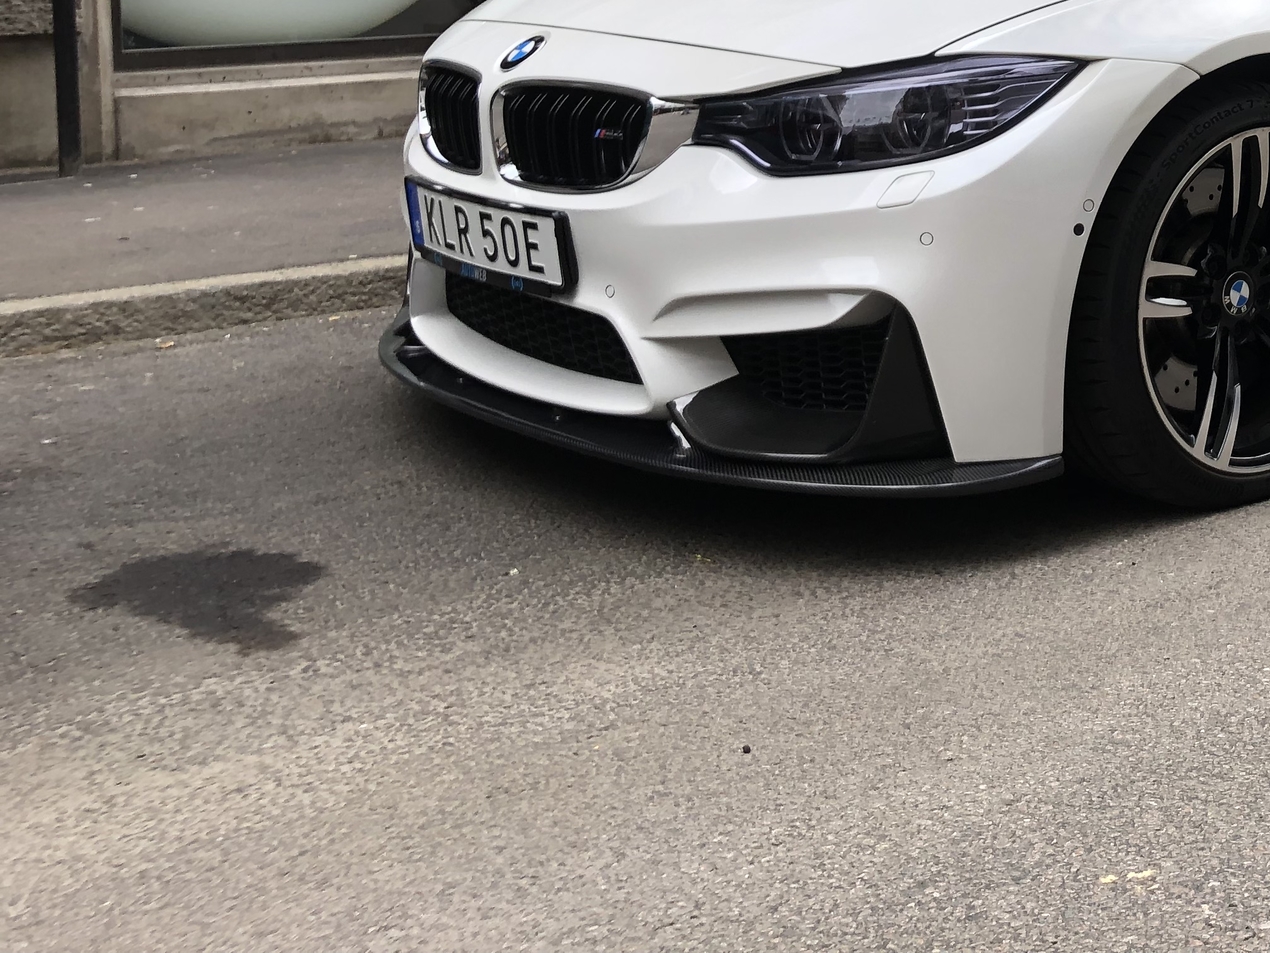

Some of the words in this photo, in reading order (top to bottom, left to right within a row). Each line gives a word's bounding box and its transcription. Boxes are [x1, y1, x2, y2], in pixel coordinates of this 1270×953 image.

[1162, 102, 1245, 171] SportContact
[424, 195, 475, 257] KLR
[479, 211, 546, 274] 50E
